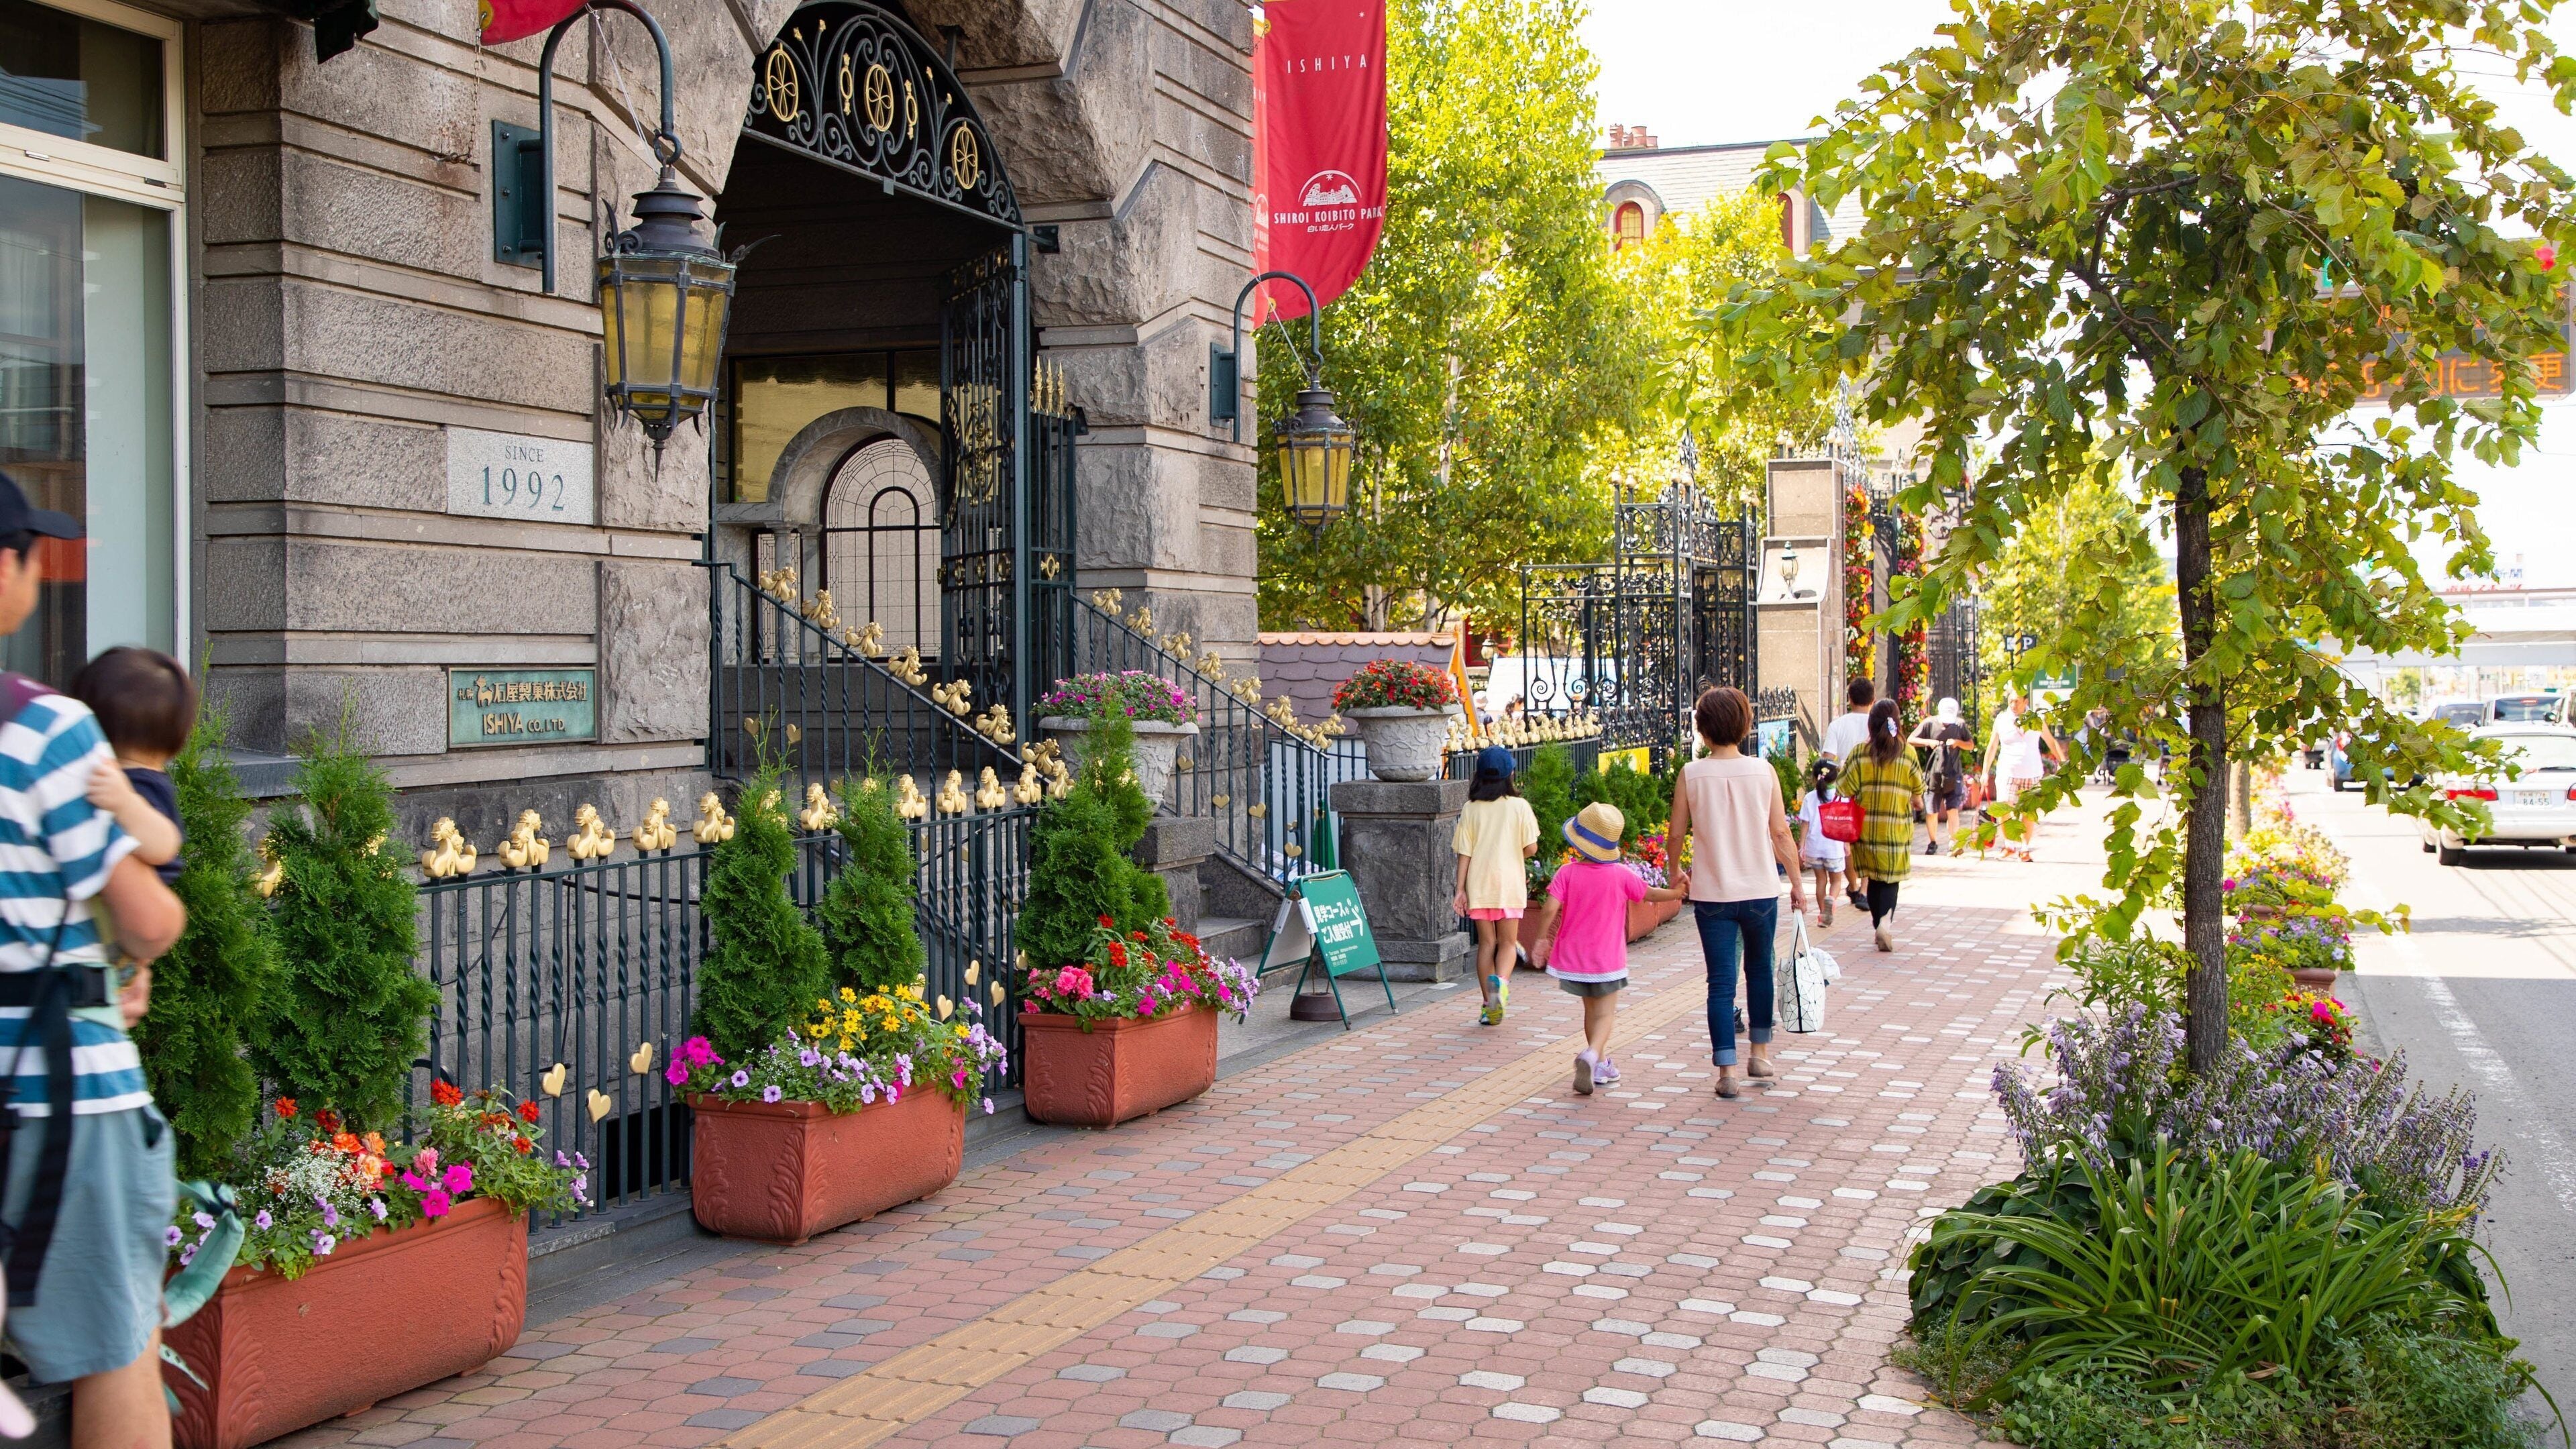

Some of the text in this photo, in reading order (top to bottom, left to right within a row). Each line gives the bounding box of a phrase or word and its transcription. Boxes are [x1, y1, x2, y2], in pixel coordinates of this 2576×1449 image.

[1287, 54, 1367, 74] ISHIYA
[1274, 205, 1383, 224] SHIROI KOIBITO PARK
[1307, 223, 1354, 233] 白い恋人パーク
[504, 445, 544, 462] SINCE
[482, 466, 565, 512] 1992
[2023, 637, 2033, 650] P
[493, 681, 588, 703] 石屋製菓株式会社
[483, 712, 523, 735] ISHIYA
